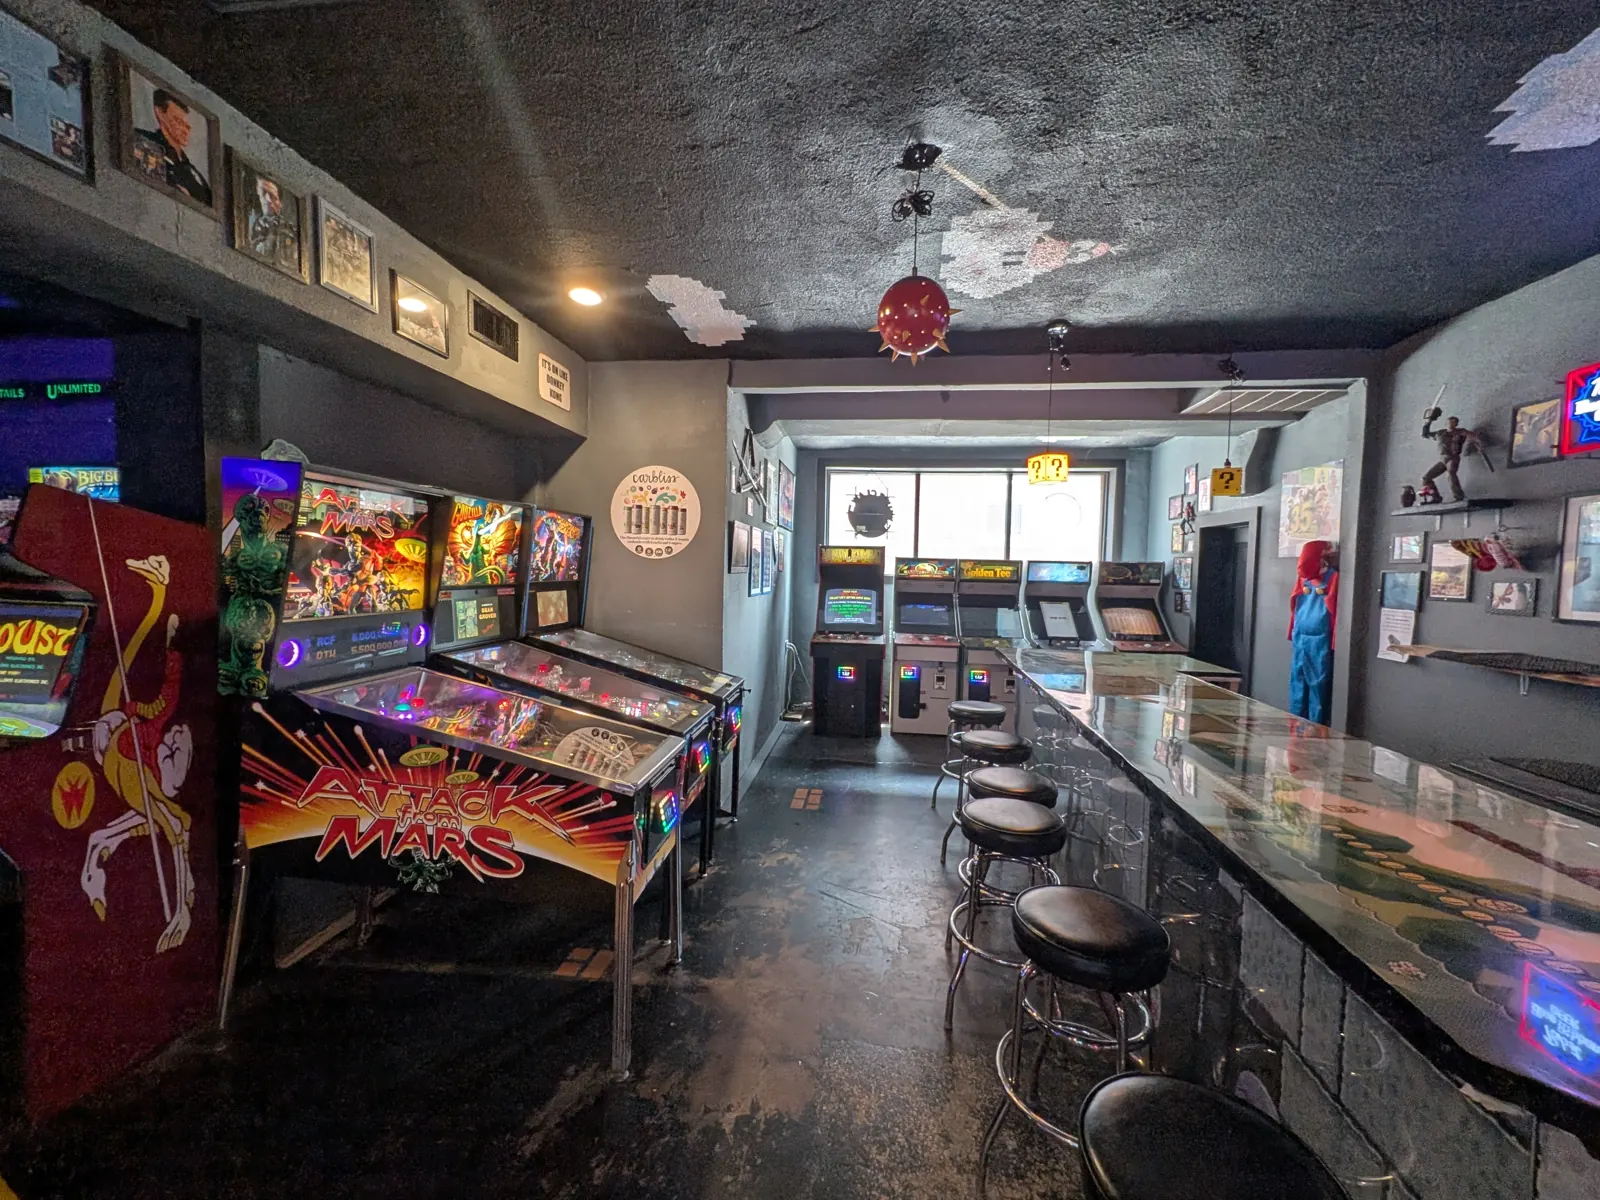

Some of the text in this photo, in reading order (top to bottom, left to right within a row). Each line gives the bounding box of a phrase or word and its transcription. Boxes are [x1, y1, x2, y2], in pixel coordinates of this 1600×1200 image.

[76, 470, 104, 488] BIG
[632, 470, 680, 484] carbliss
[320, 511, 395, 543] MARS
[451, 502, 483, 528] GODZILLA
[963, 566, 994, 578] Golden
[994, 566, 1012, 578] Tee
[297, 765, 576, 848] ATTACK
[399, 804, 463, 829] from
[315, 815, 526, 884] MARS
